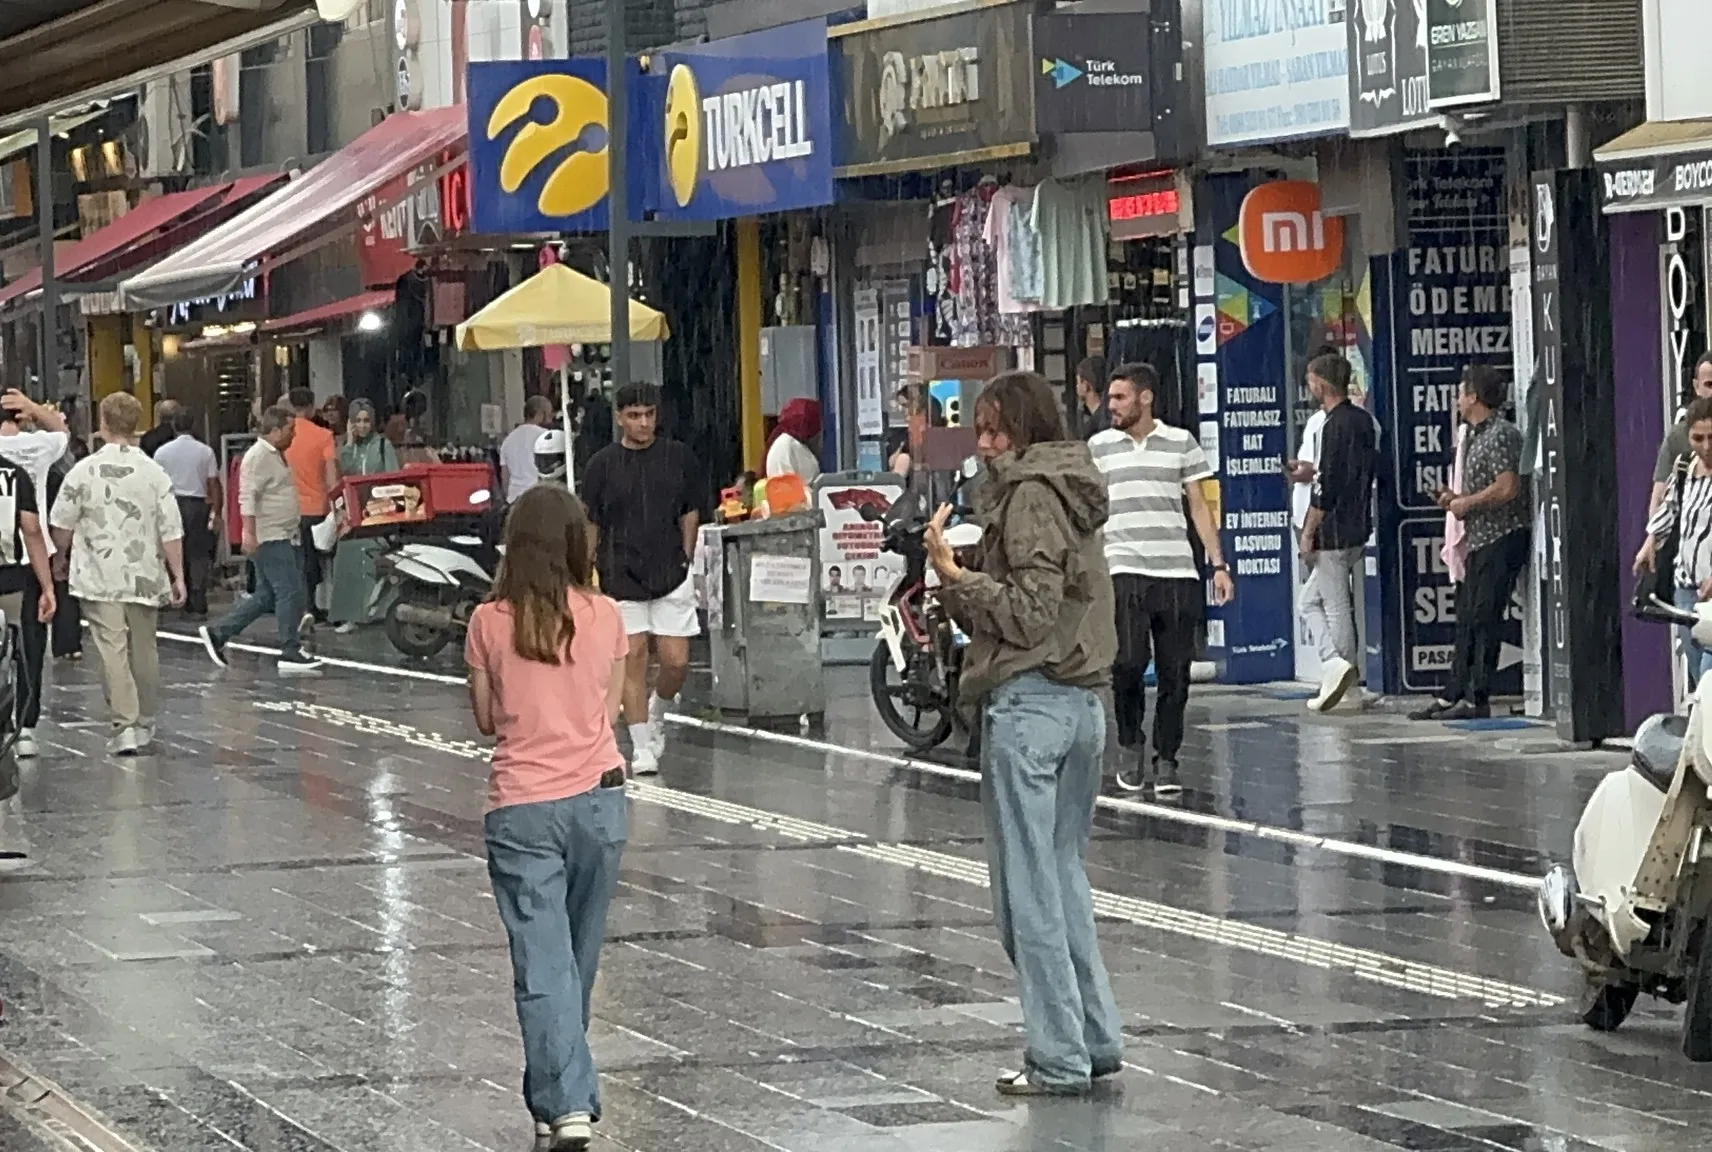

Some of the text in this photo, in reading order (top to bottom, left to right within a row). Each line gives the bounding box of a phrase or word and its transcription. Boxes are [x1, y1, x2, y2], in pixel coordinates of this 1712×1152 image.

[1086, 60, 1115, 72] Türk
[1086, 74, 1142, 86] Telekom
[703, 80, 812, 171] TURKCELL
[1411, 326, 1513, 356] MERKEZ
[1412, 385, 1456, 412] FAT
[1223, 410, 1281, 428] FATURASIZ
[1242, 434, 1263, 451] HAT
[1414, 425, 1442, 453] EK
[1226, 509, 1288, 529] EV İNTERNET
[1234, 535, 1281, 554] BAŞVURU
[1237, 557, 1280, 575] NOKTASI
